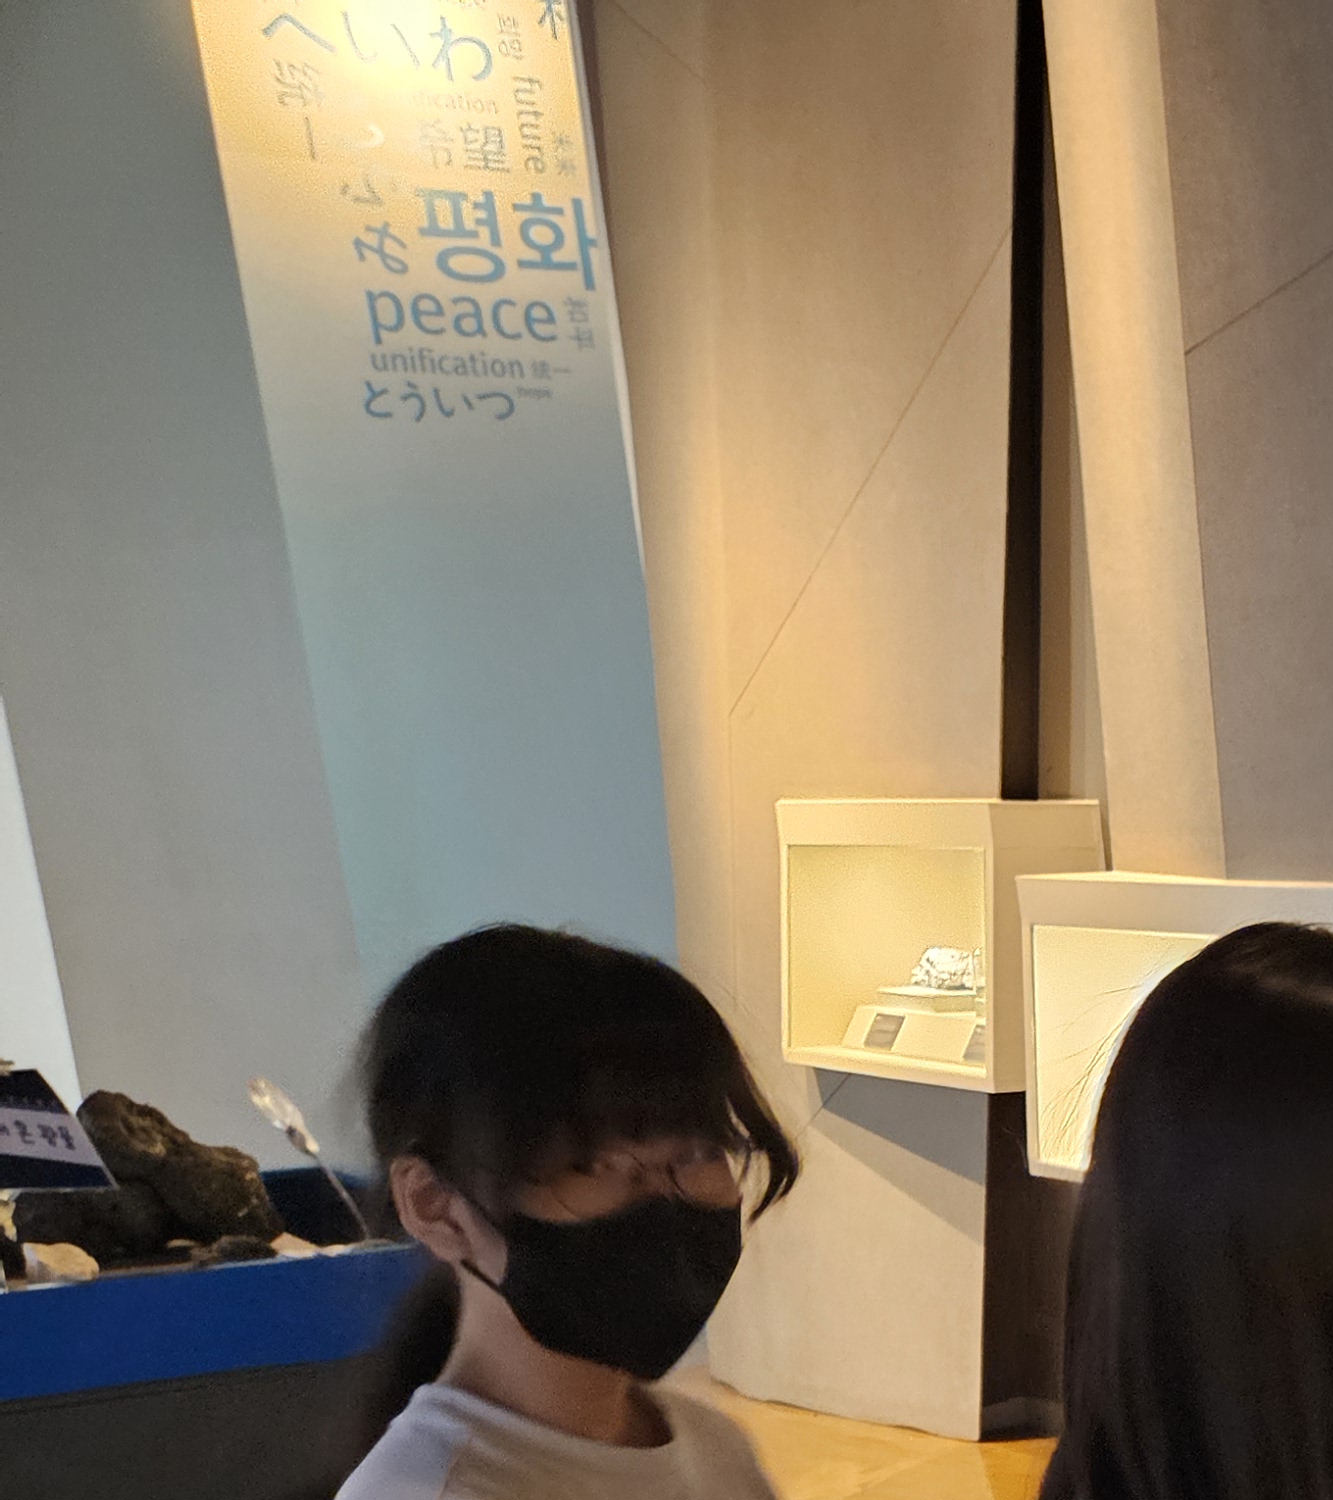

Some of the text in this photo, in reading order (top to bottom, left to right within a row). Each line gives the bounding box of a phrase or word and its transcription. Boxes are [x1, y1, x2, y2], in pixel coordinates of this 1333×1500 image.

[261, 12, 494, 82] へいわ
[413, 189, 598, 291] 평화
[365, 289, 558, 345] peace
[370, 346, 526, 380] unification
[363, 380, 516, 423] とういつ
